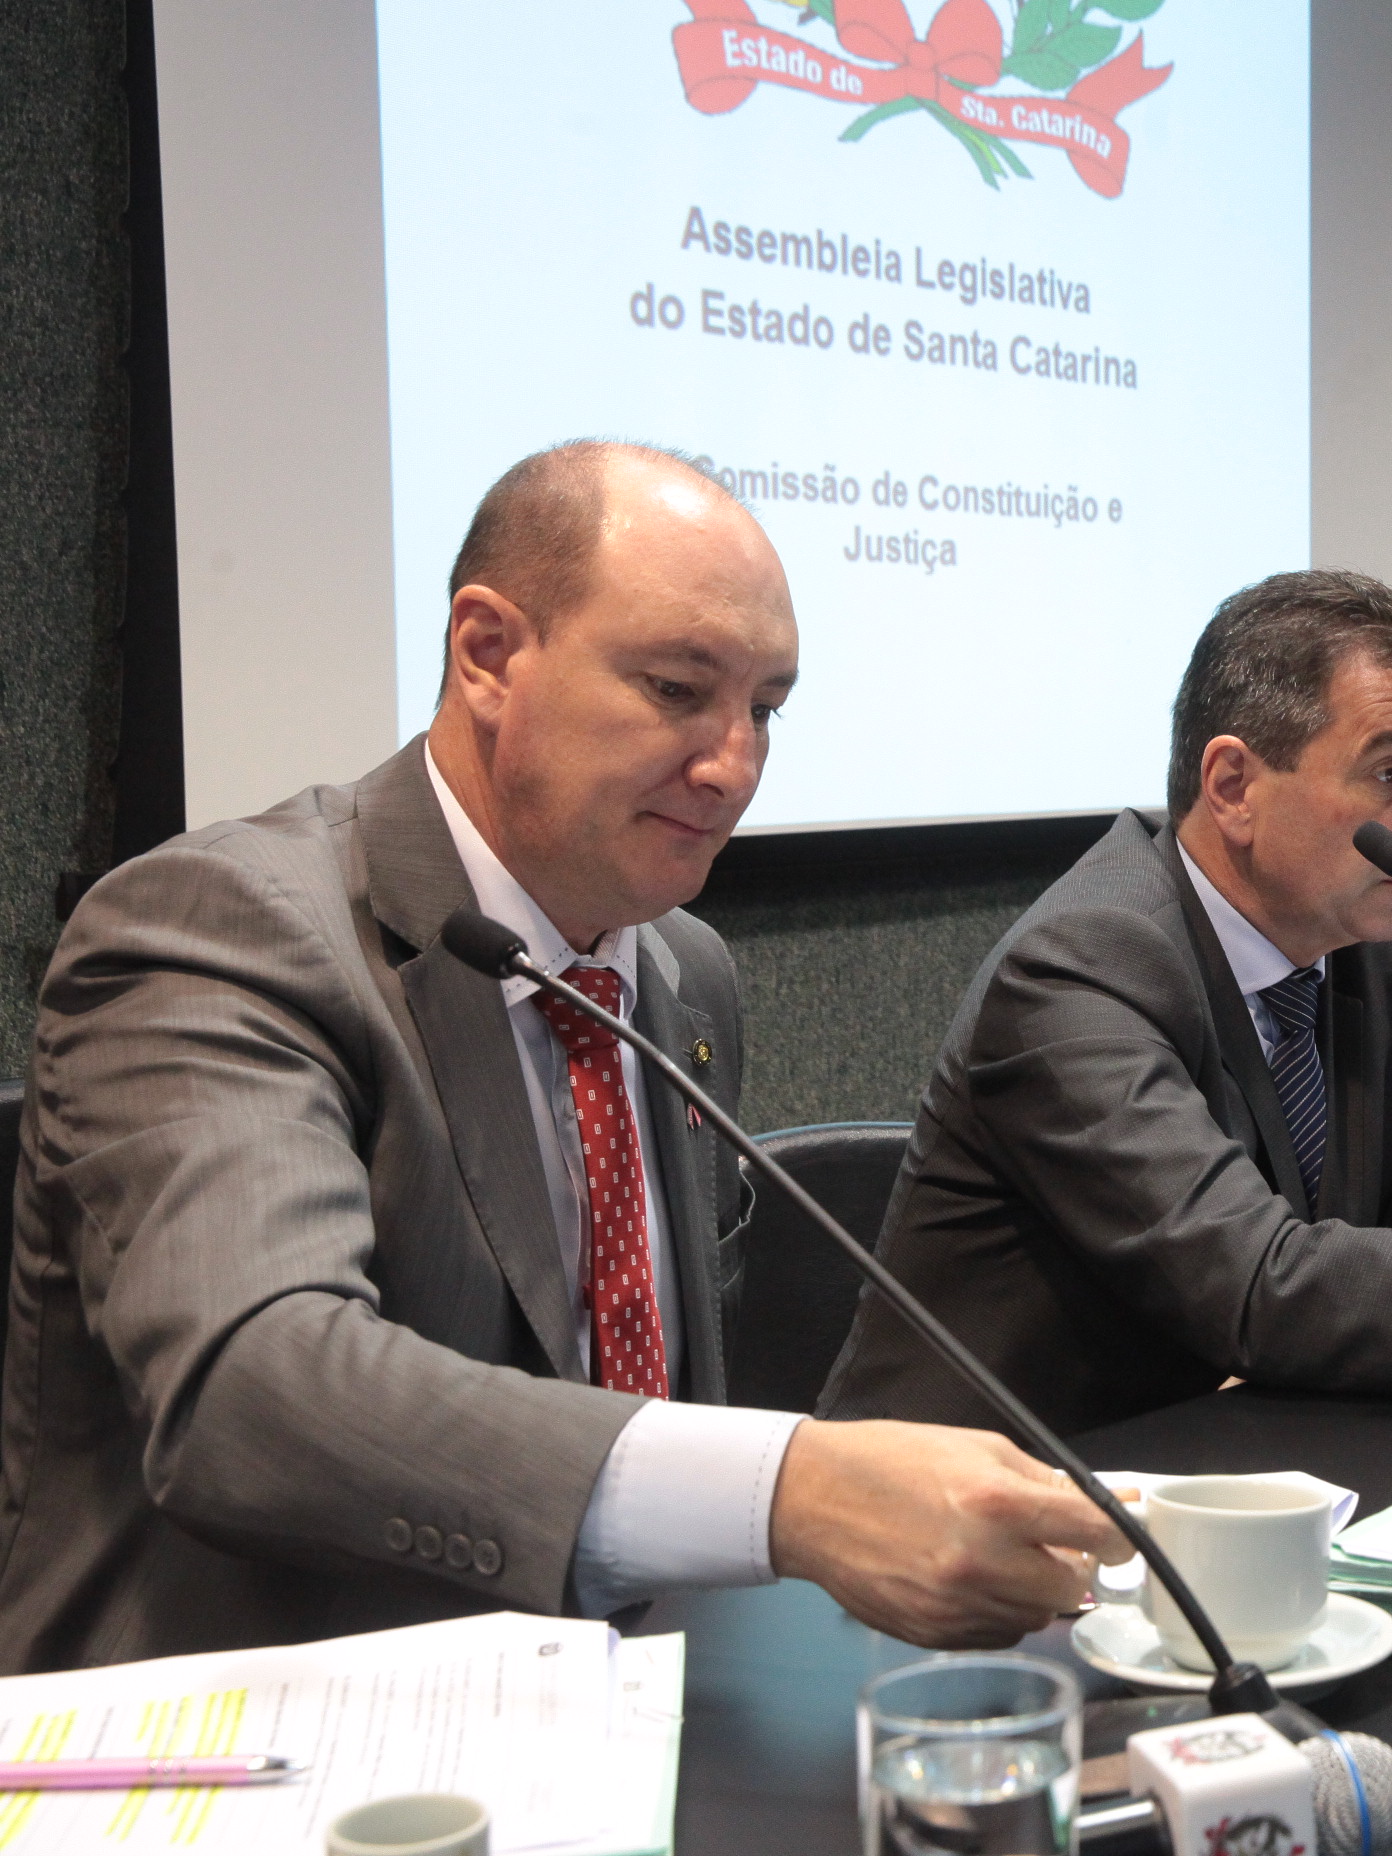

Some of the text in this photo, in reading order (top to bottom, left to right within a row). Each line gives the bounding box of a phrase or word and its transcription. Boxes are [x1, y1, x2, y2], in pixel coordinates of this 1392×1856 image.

[722, 29, 864, 96] Estado de
[960, 95, 1112, 160] Sta. Catarina
[681, 205, 1092, 315] Assembleia Legislativa
[629, 283, 1138, 390] do Estado de Santa Catarina
[872, 469, 908, 508] de
[918, 474, 1099, 528] Constituição
[1107, 497, 1123, 524] e
[843, 525, 958, 575] Justiça
